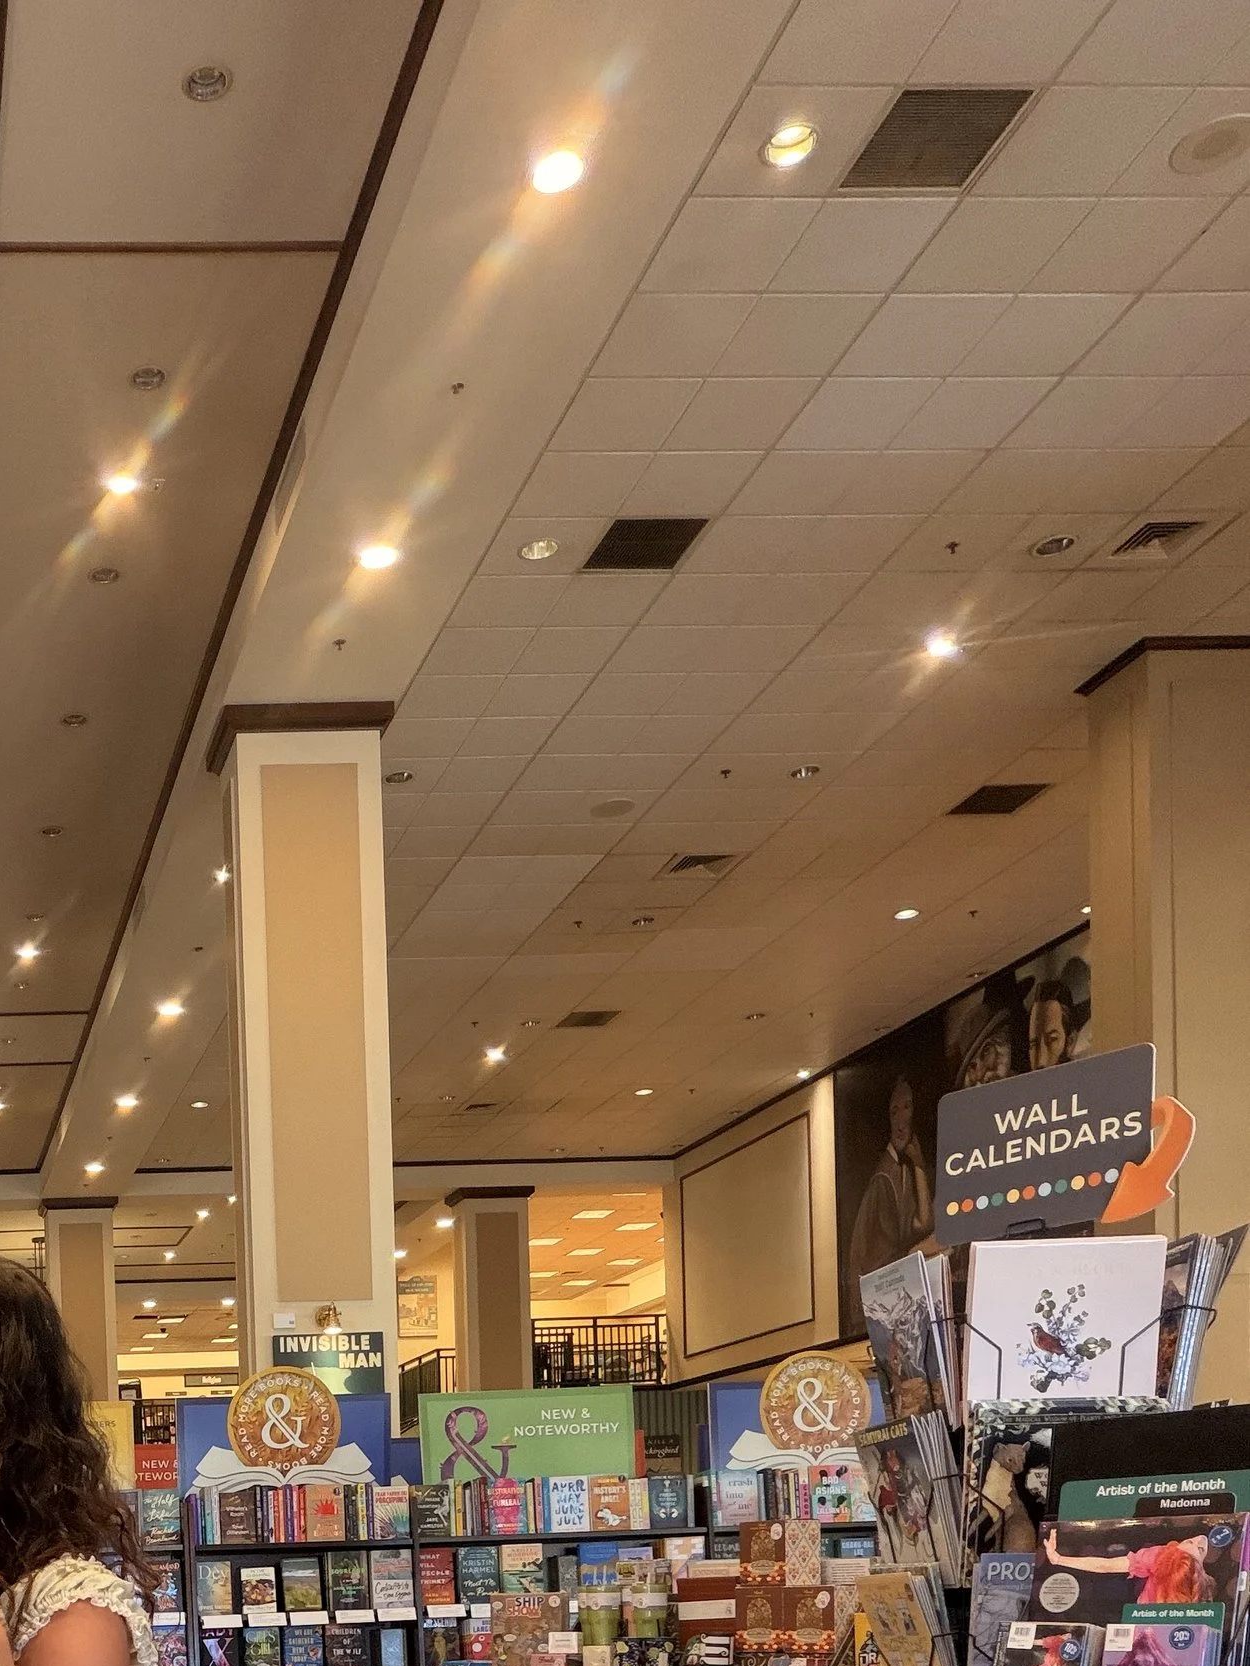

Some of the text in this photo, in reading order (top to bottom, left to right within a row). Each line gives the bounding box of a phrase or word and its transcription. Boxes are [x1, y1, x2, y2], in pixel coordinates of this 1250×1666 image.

[994, 1093, 1088, 1134] WALL
[945, 1111, 1143, 1176] CALENDARS
[279, 1334, 370, 1353] INVISIBLE
[338, 1353, 383, 1368] MAN
[840, 1373, 861, 1405] READ
[310, 1391, 330, 1421] READ
[770, 1361, 832, 1442] READ MORE BOOKS
[238, 1378, 300, 1458] READ MORE BOOKS
[541, 1407, 591, 1421] NEW &
[513, 1422, 620, 1437] NOTEWORTHY
[857, 1423, 908, 1446] SAMURAI CATS
[309, 1427, 330, 1459] MORE
[142, 1459, 170, 1469] NEW
[728, 1478, 753, 1488] crash
[822, 1476, 839, 1486] BAD
[1096, 1478, 1226, 1497] Artist of the Month
[725, 1491, 744, 1500] into
[815, 1486, 847, 1496] ASIANS
[1159, 1497, 1211, 1509] Madonna
[558, 1515, 584, 1526] JULY
[462, 1566, 496, 1574] HARMEL
[515, 1597, 545, 1608] SHIP
[1131, 1608, 1215, 1618] Artist of the Month
